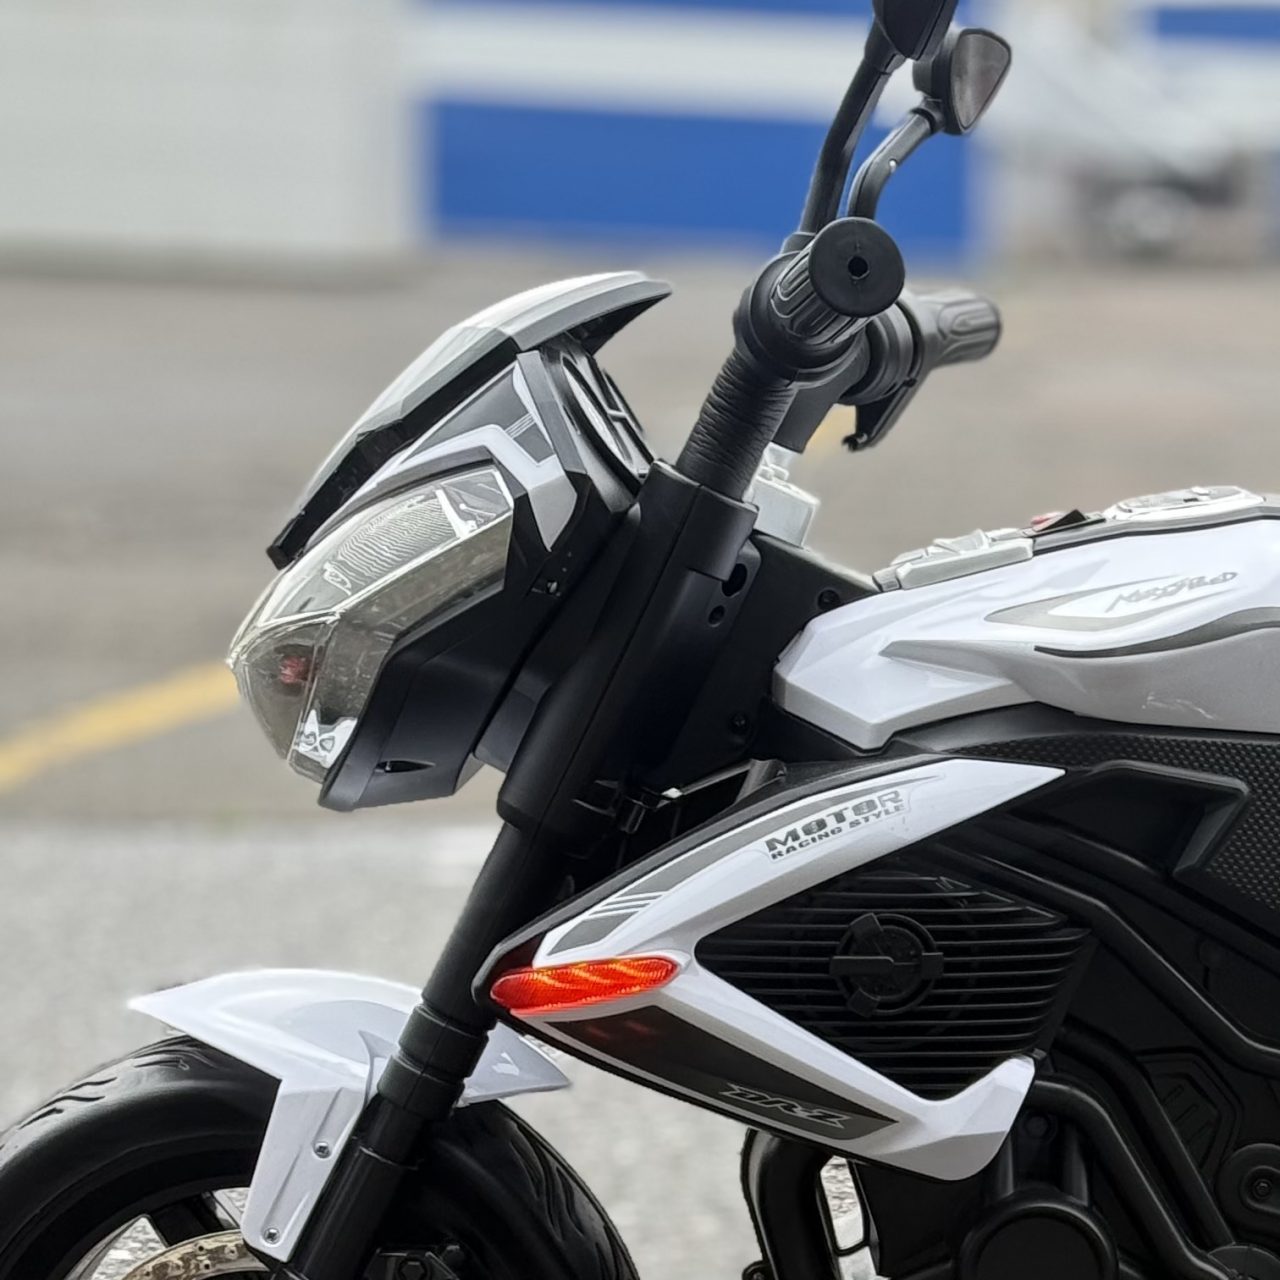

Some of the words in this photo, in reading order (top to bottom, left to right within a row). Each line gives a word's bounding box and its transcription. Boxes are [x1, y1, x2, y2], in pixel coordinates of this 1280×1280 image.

[765, 790, 903, 853] MOTOR
[771, 826, 842, 860] RACING
[849, 803, 905, 829] STYLE
